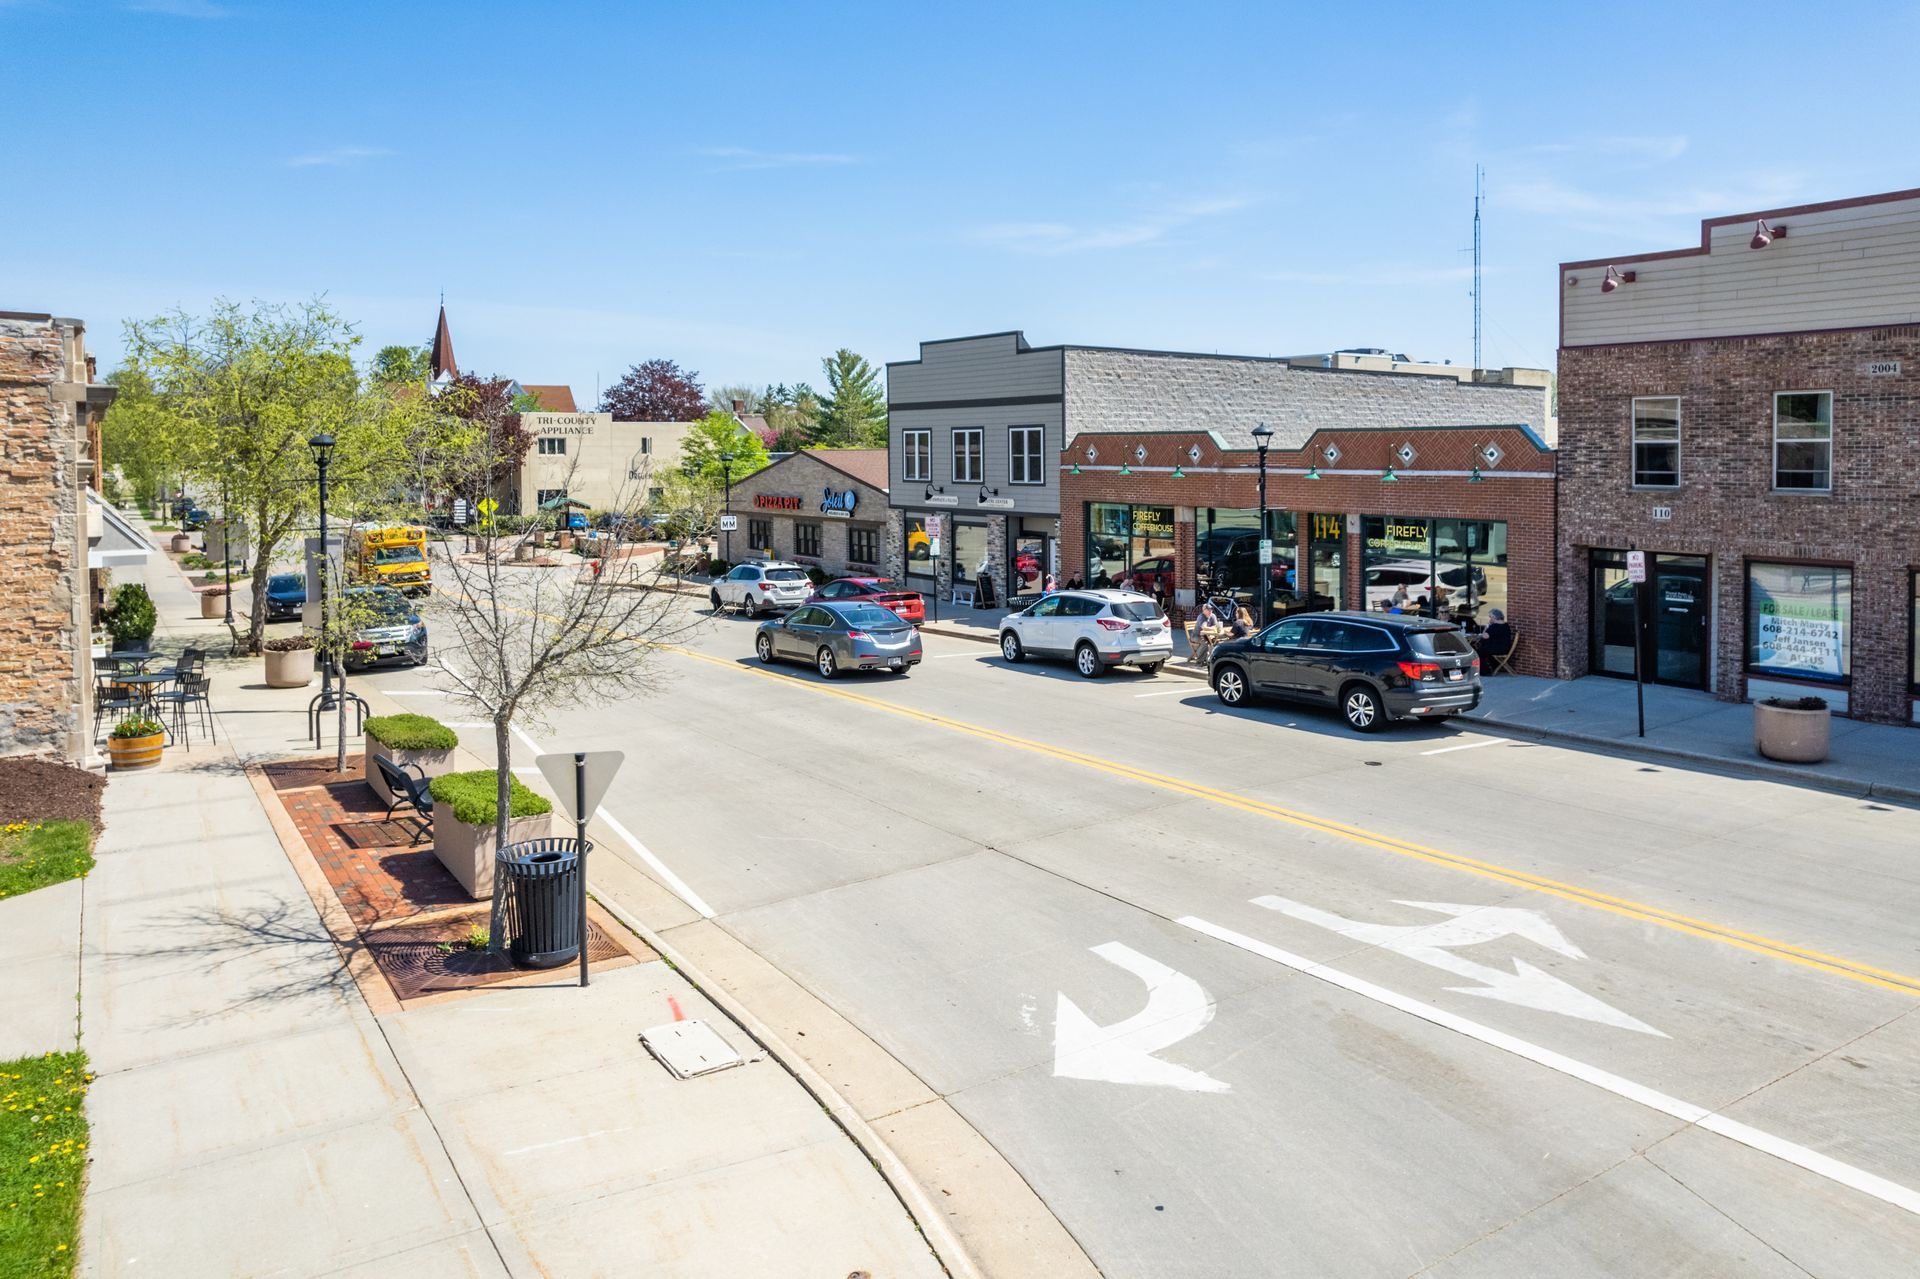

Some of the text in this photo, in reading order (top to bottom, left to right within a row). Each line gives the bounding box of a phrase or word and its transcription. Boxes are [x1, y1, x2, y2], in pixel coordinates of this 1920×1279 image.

[1871, 363, 1897, 373] 2004
[536, 416, 597, 425] TRI-COUNTY
[539, 426, 594, 435] APPLIANCE
[760, 496, 800, 512] PIZZA PIT
[1132, 510, 1161, 521] FIREFLY
[1654, 508, 1670, 518] 110
[1132, 522, 1174, 533] COFFEEHOUSE
[1314, 515, 1341, 539] 114
[1386, 525, 1428, 538] FIREFLY
[1763, 603, 1779, 614] FOR
[1782, 605, 1804, 617] SALE
[1810, 608, 1839, 619] LEASE
[1771, 617, 1830, 632] Mitch Marty
[1762, 624, 1839, 640] 608-214-6742
[1774, 634, 1827, 647] Jeff Jansen
[1762, 641, 1837, 656] 608-444-4111
